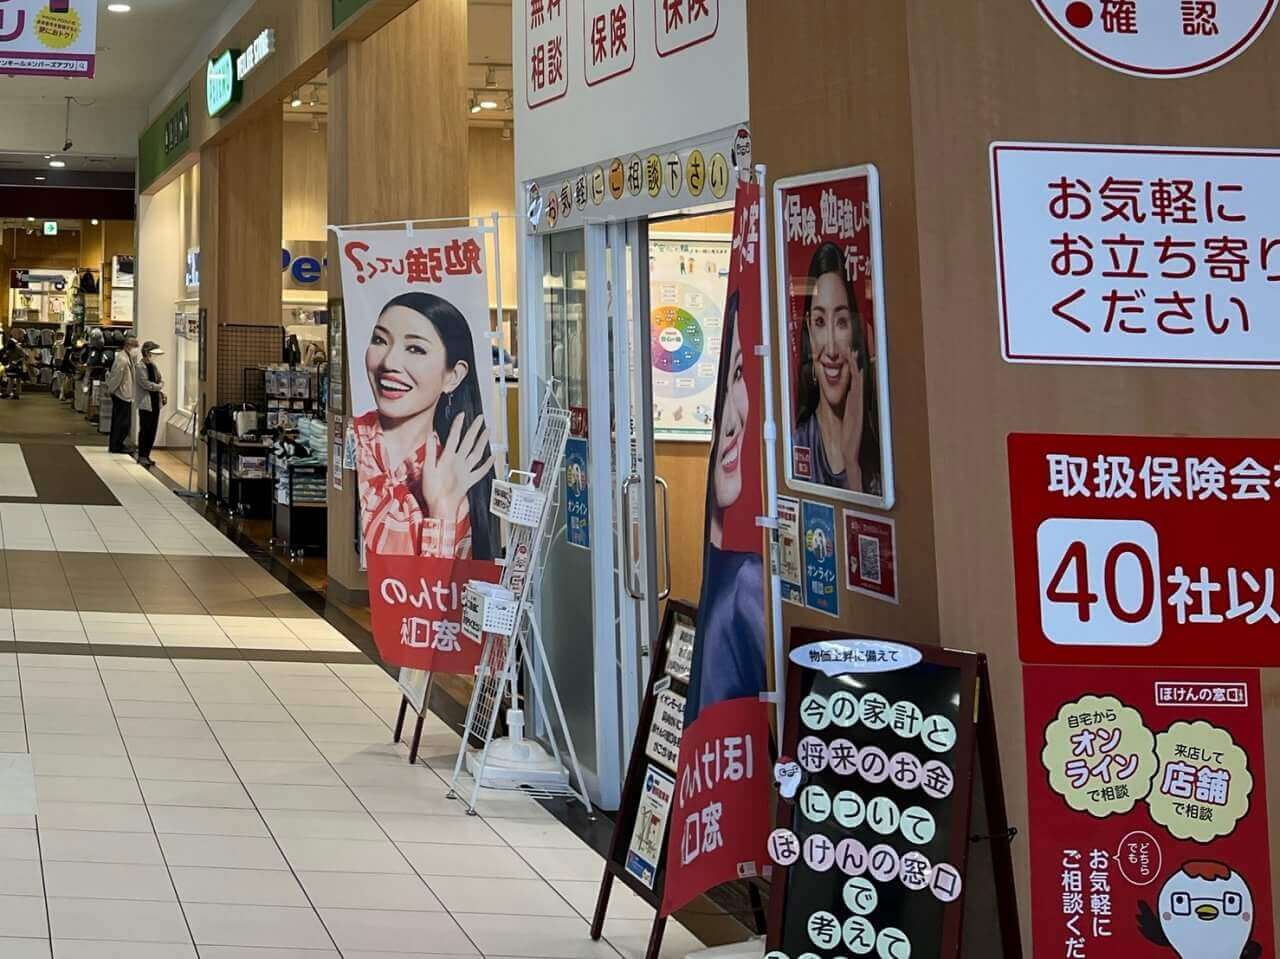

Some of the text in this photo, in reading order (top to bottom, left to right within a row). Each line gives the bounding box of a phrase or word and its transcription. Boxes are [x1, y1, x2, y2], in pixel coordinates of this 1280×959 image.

[590, 3, 627, 67] 保険
[531, 36, 563, 92] 相談
[545, 154, 724, 223] お気軽にご相談下さい
[1048, 176, 1246, 225] お気軽に
[1051, 289, 1250, 335] ください
[1046, 453, 1280, 501] 取扱保険会
[807, 565, 836, 582] オンライン
[809, 649, 900, 663] 物価上昇に備えて
[1159, 687, 1243, 702] ほけんの窓口
[802, 696, 950, 747] 今の家計と
[1067, 708, 1117, 729] 自宅から
[1070, 727, 1121, 757] オン
[1174, 743, 1225, 765] 来店して
[800, 737, 952, 796] 将来のお金
[1065, 753, 1138, 789] ライン
[1162, 761, 1231, 806] 店舗
[1086, 784, 1130, 803] で相談
[1172, 801, 1214, 822] で相談
[803, 791, 932, 842] について
[772, 833, 959, 898] ほけんの窓口
[1127, 843, 1138, 864] でも
[1139, 842, 1150, 876] どちら
[848, 884, 873, 910] で
[1061, 848, 1086, 959] ご相談くだ
[1088, 848, 1113, 938] お気軽に
[811, 914, 907, 959] 考えて
